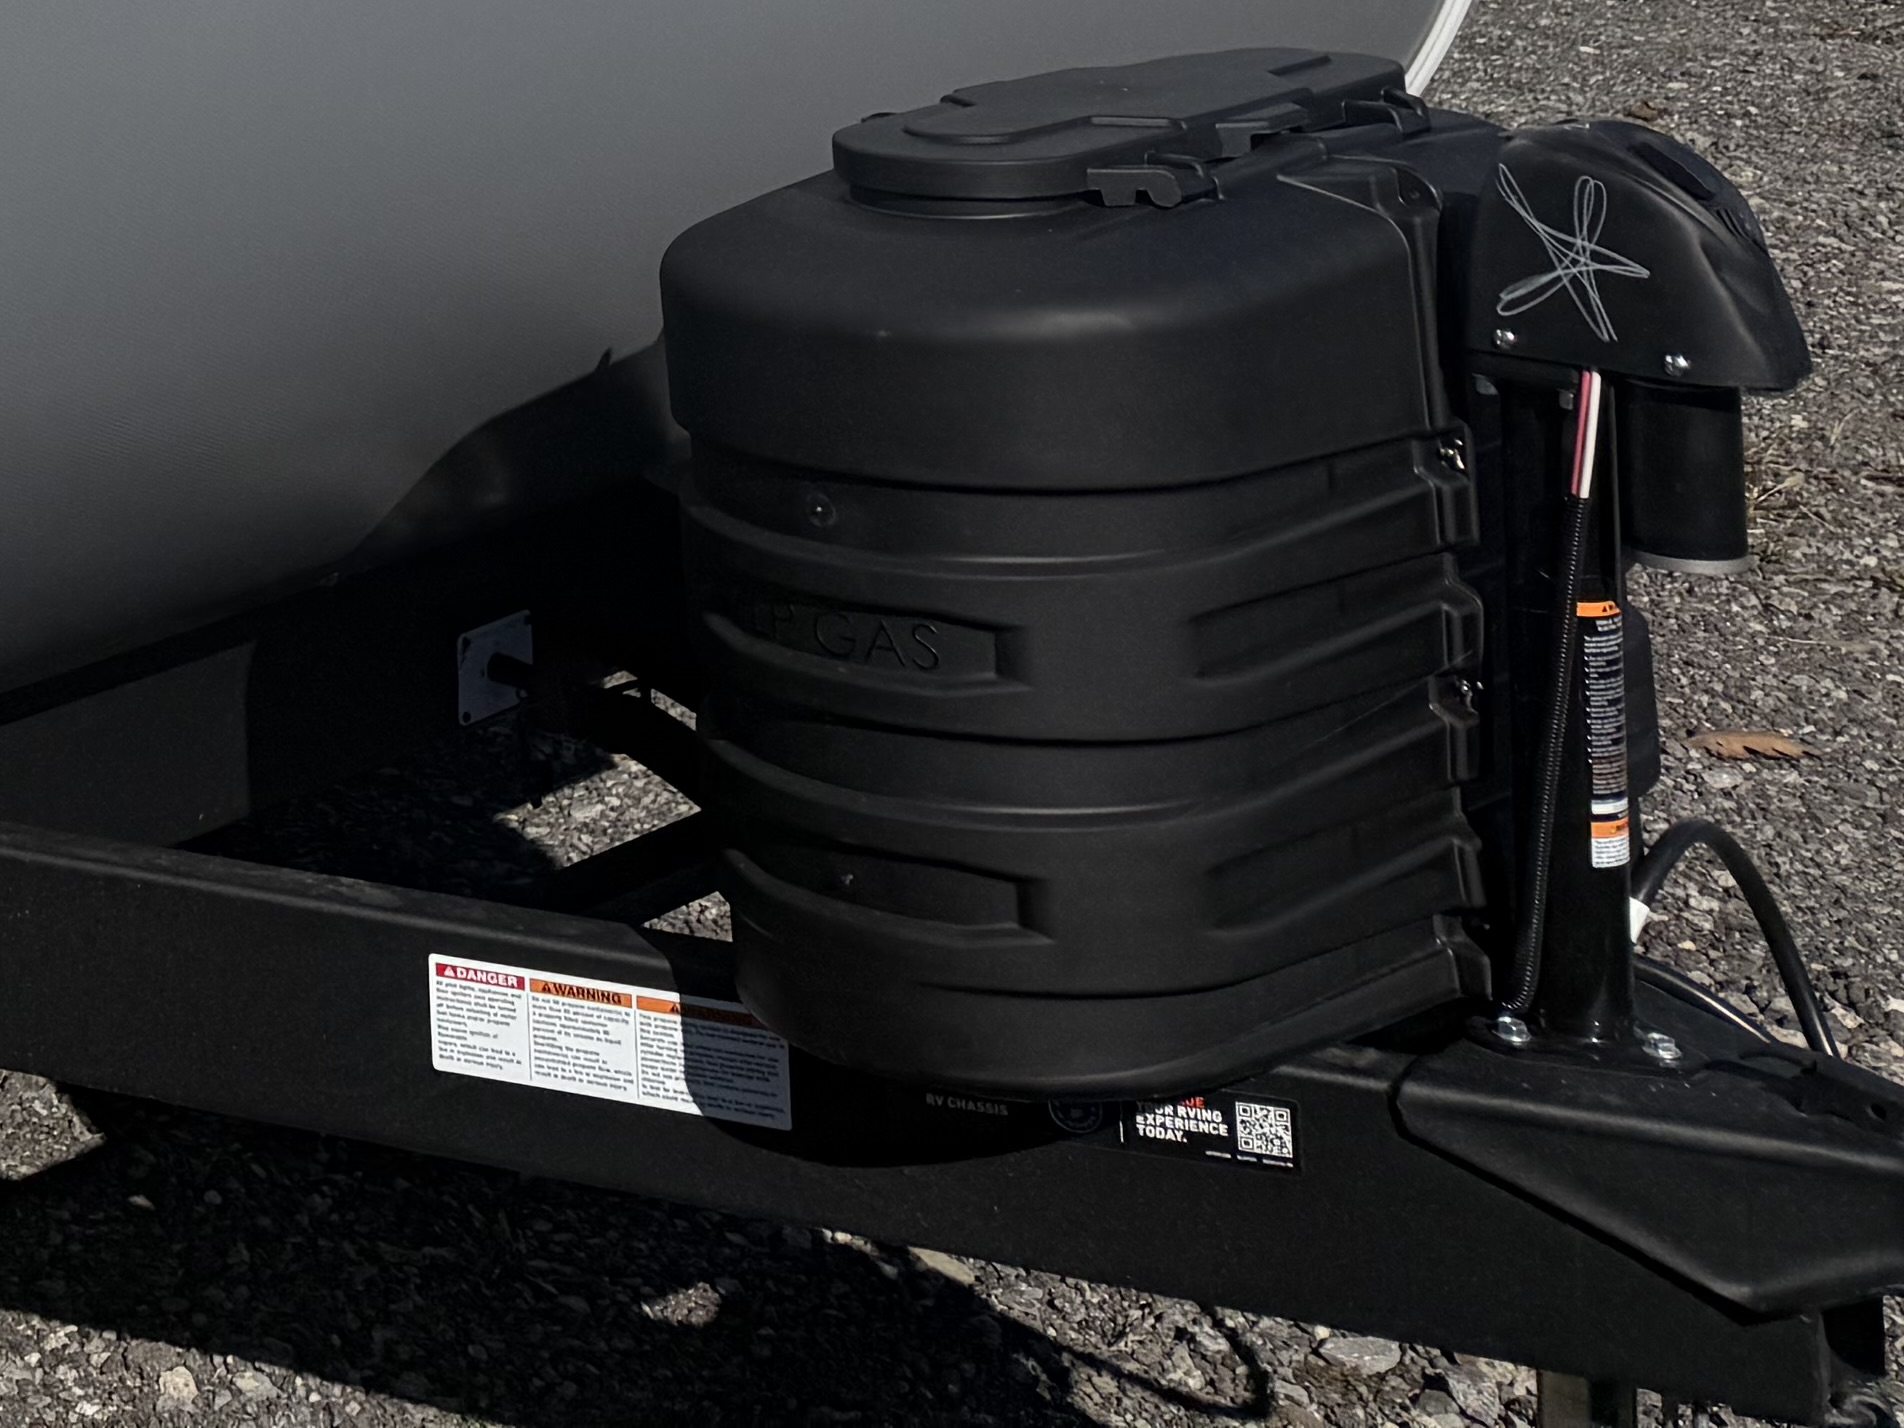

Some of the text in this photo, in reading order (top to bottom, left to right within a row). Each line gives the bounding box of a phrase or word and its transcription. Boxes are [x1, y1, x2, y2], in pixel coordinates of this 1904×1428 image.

[814, 611, 940, 671] GAS
[456, 966, 519, 988] DANGER
[551, 982, 623, 1006] WARNING
[925, 1091, 1009, 1117] RV CHASSIS
[1176, 1104, 1223, 1124] RVING
[1135, 1113, 1229, 1138] EXPERIENCE
[1135, 1123, 1189, 1144] TODAY.
